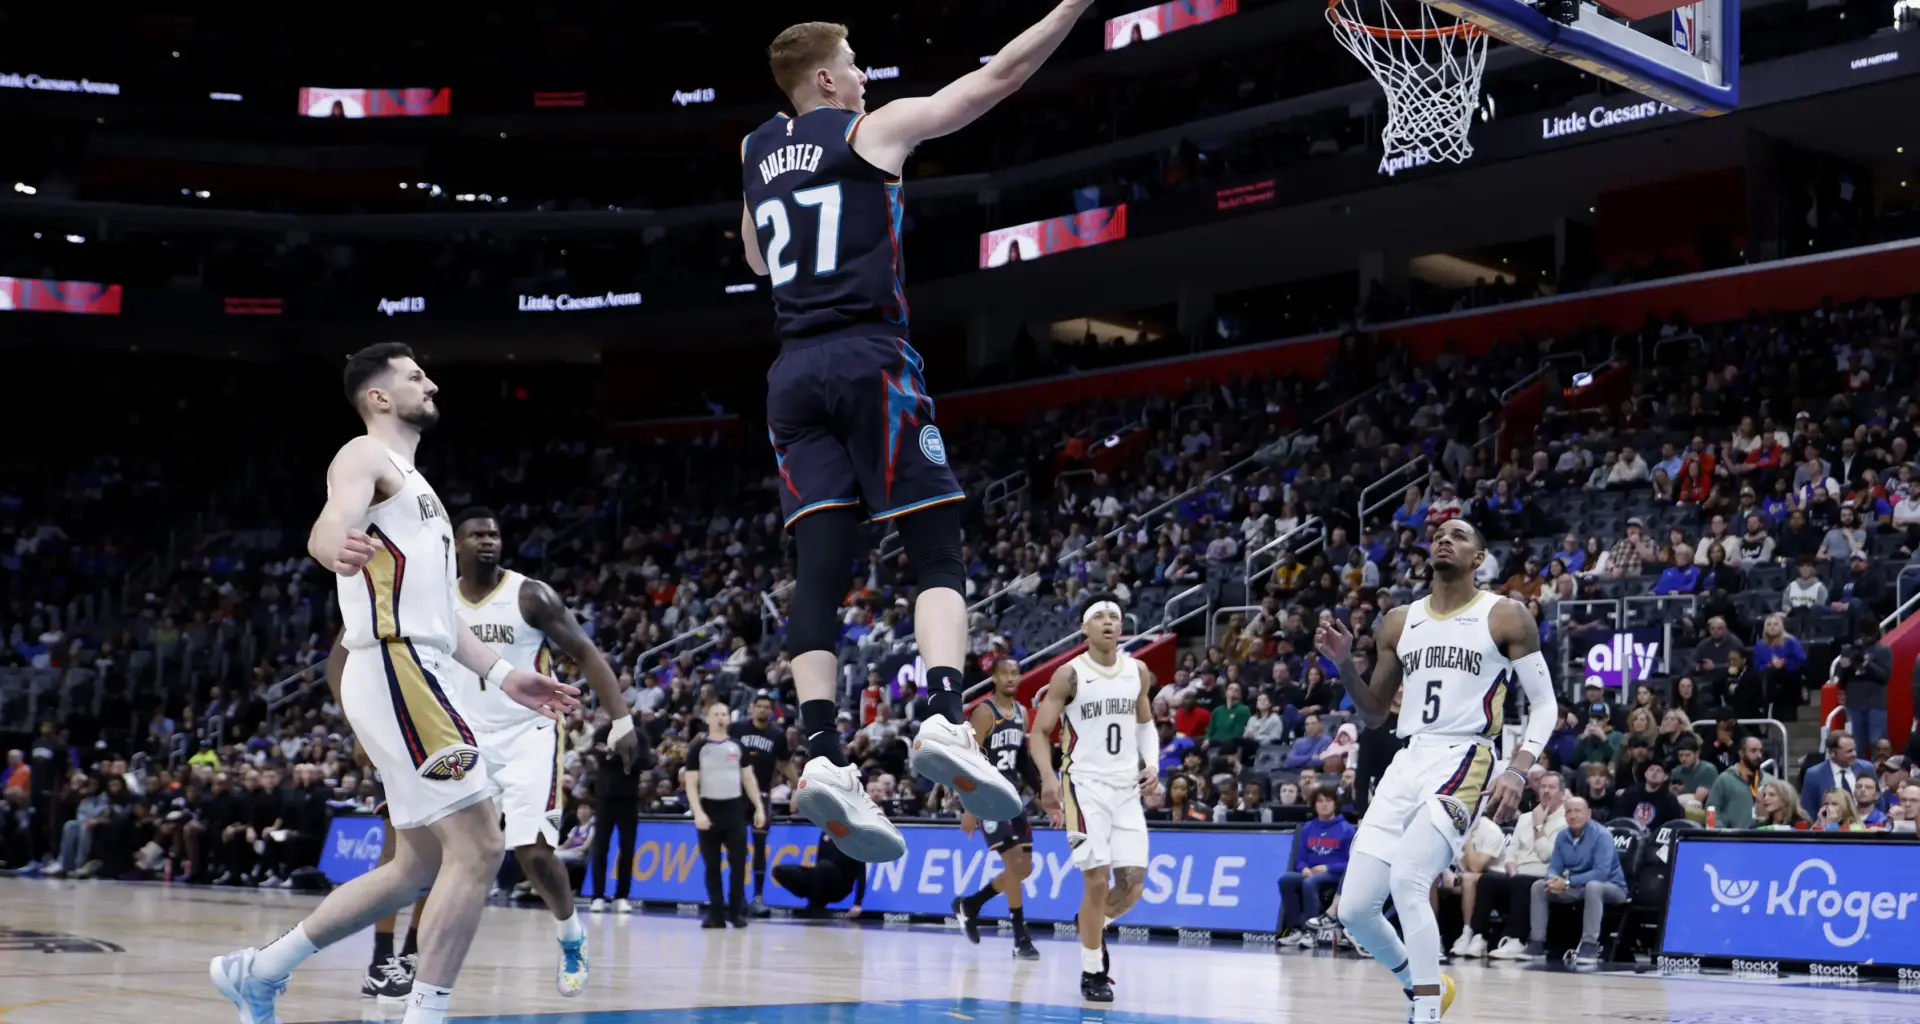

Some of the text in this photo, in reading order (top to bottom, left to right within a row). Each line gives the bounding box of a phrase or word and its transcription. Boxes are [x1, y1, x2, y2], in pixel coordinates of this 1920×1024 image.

[865, 66, 900, 81] Arena
[672, 89, 701, 107] April
[1542, 111, 1587, 139] Little
[1589, 101, 1656, 128] Caesars
[758, 143, 824, 185] HUERTER
[1377, 150, 1413, 177] April
[755, 181, 843, 289] 27
[377, 297, 409, 316] April
[518, 290, 642, 311] Little Caesars Arena
[469, 624, 515, 645] RLEANS
[1425, 645, 1482, 676] ORLEANS
[1587, 632, 1659, 680] ally
[897, 655, 928, 688] all
[1080, 698, 1137, 721] NEW ORLEAN
[1422, 679, 1443, 724] 5
[1105, 722, 1122, 755] 0
[1107, 853, 1247, 907] SLE
[1766, 857, 1918, 948] Kroger
[1054, 922, 1077, 934] Stock
[1118, 925, 1149, 937] StockX
[1178, 928, 1211, 940] StockX
[1657, 955, 1700, 968] StockX
[1732, 958, 1779, 972] StockX
[1809, 963, 1858, 976] StockX
[1898, 967, 1920, 980] Sto
